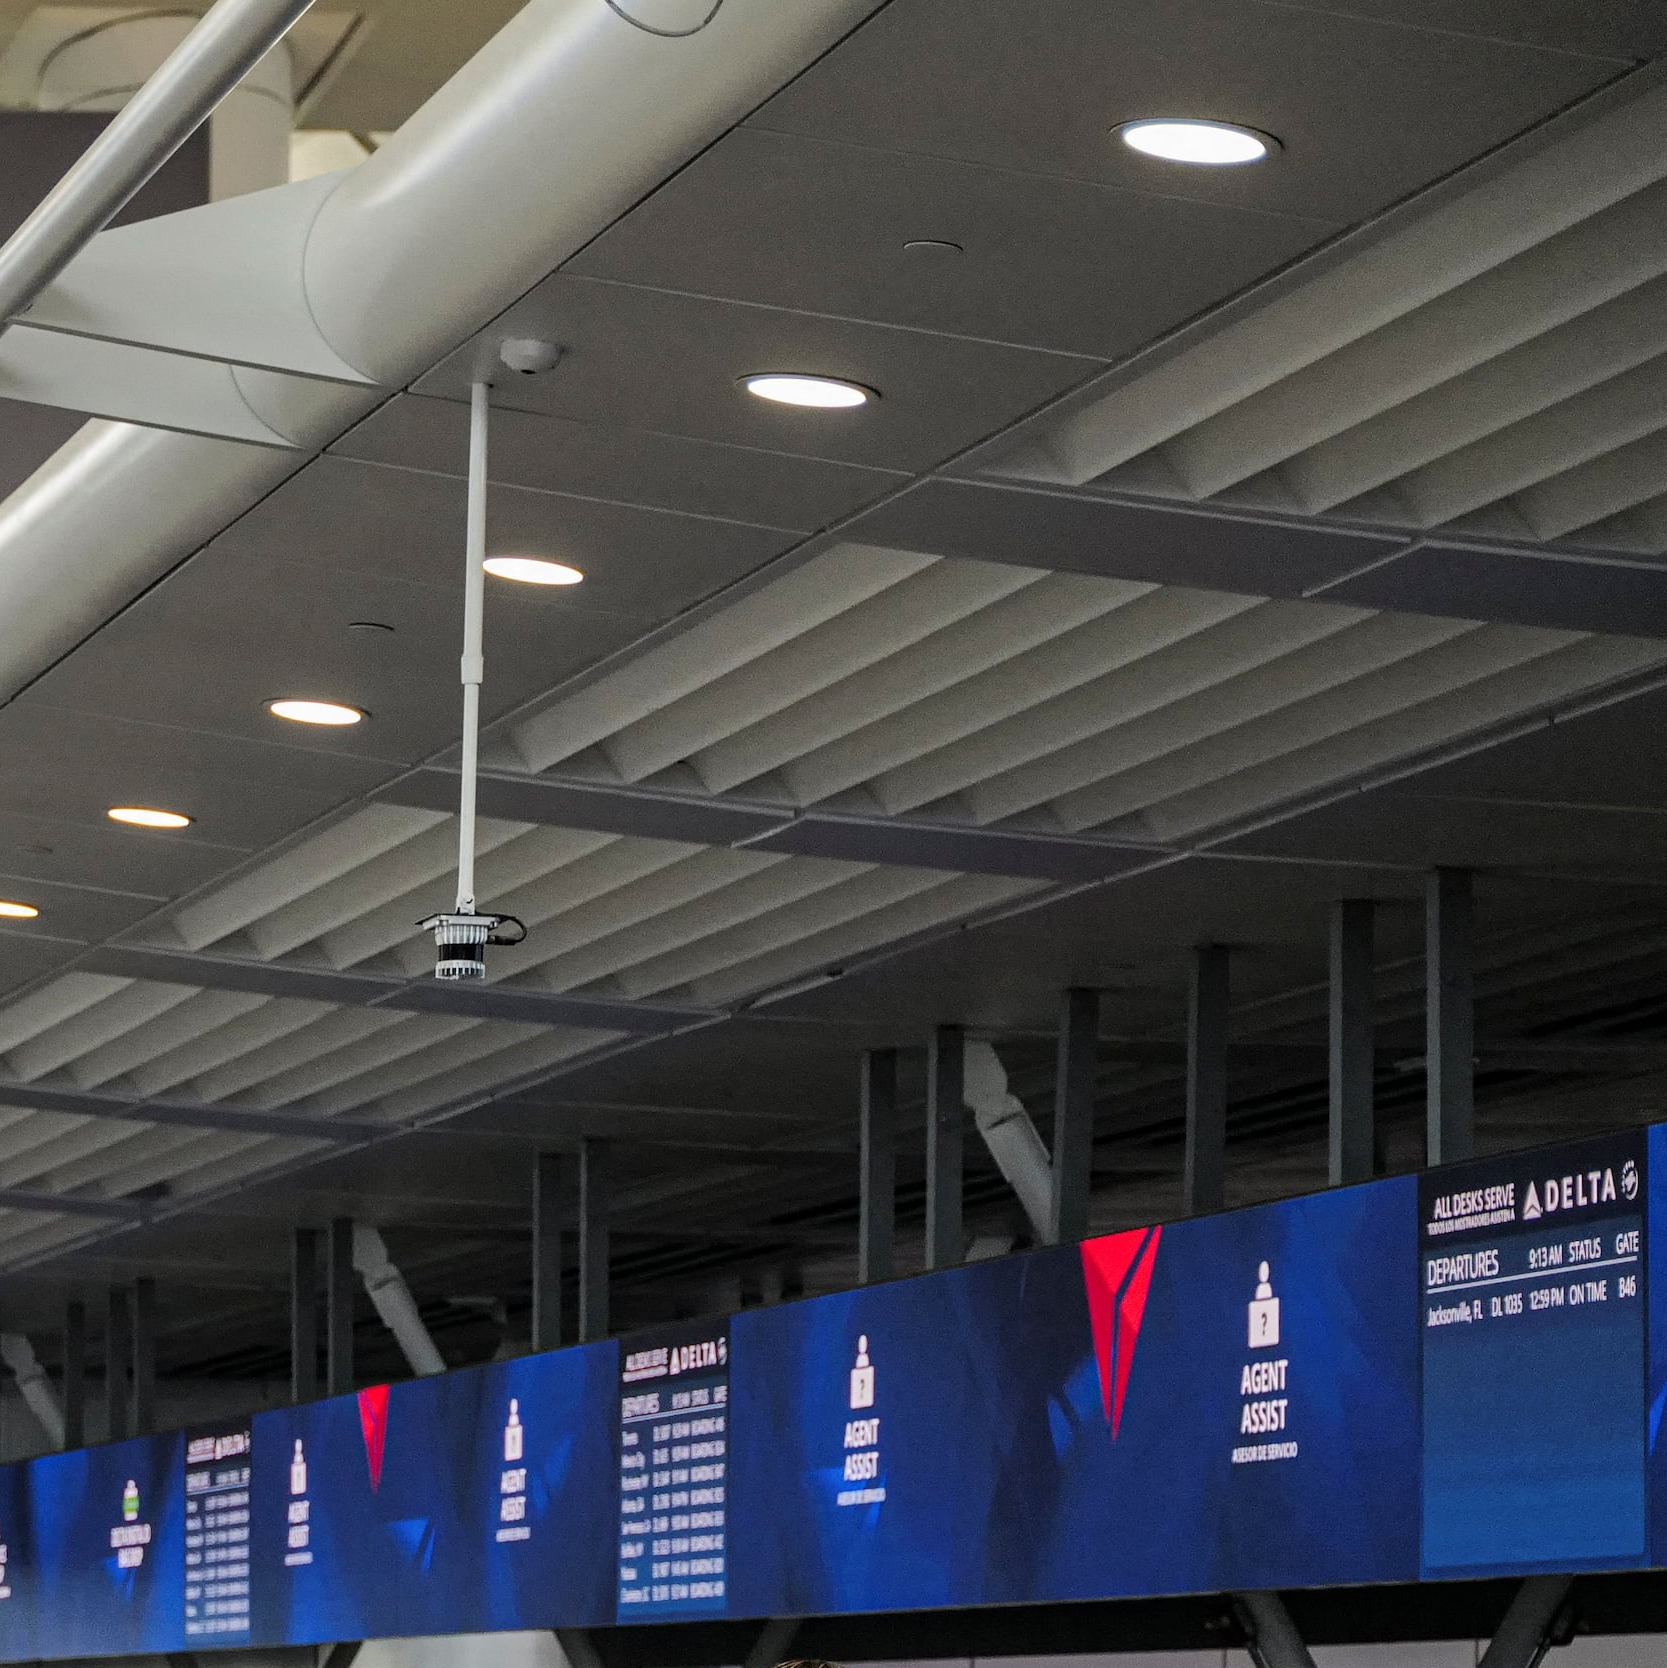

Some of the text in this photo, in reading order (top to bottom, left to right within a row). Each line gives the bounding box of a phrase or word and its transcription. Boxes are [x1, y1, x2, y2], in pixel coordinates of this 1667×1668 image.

[1434, 1183, 1515, 1219] ALL DESKS SERVE
[1545, 1168, 1616, 1212] DELTA
[1428, 1231, 1639, 1286] DEPARTURES 9:13 AM STATUS GATE
[1427, 1302, 1472, 1327] Jacksonville,
[1473, 1300, 1483, 1320] FL
[1492, 1296, 1503, 1317] DL
[1505, 1293, 1523, 1315] 1035
[1550, 1286, 1564, 1306] PM
[1569, 1284, 1585, 1306] ON
[1586, 1280, 1607, 1303] TIME
[1619, 1275, 1636, 1298] B46
[680, 1342, 717, 1371] DELTA
[1240, 1359, 1288, 1395] AGENT
[844, 1418, 879, 1448] AGENT
[1240, 1399, 1288, 1434] ASSIST
[844, 1451, 879, 1481] ASSIST
